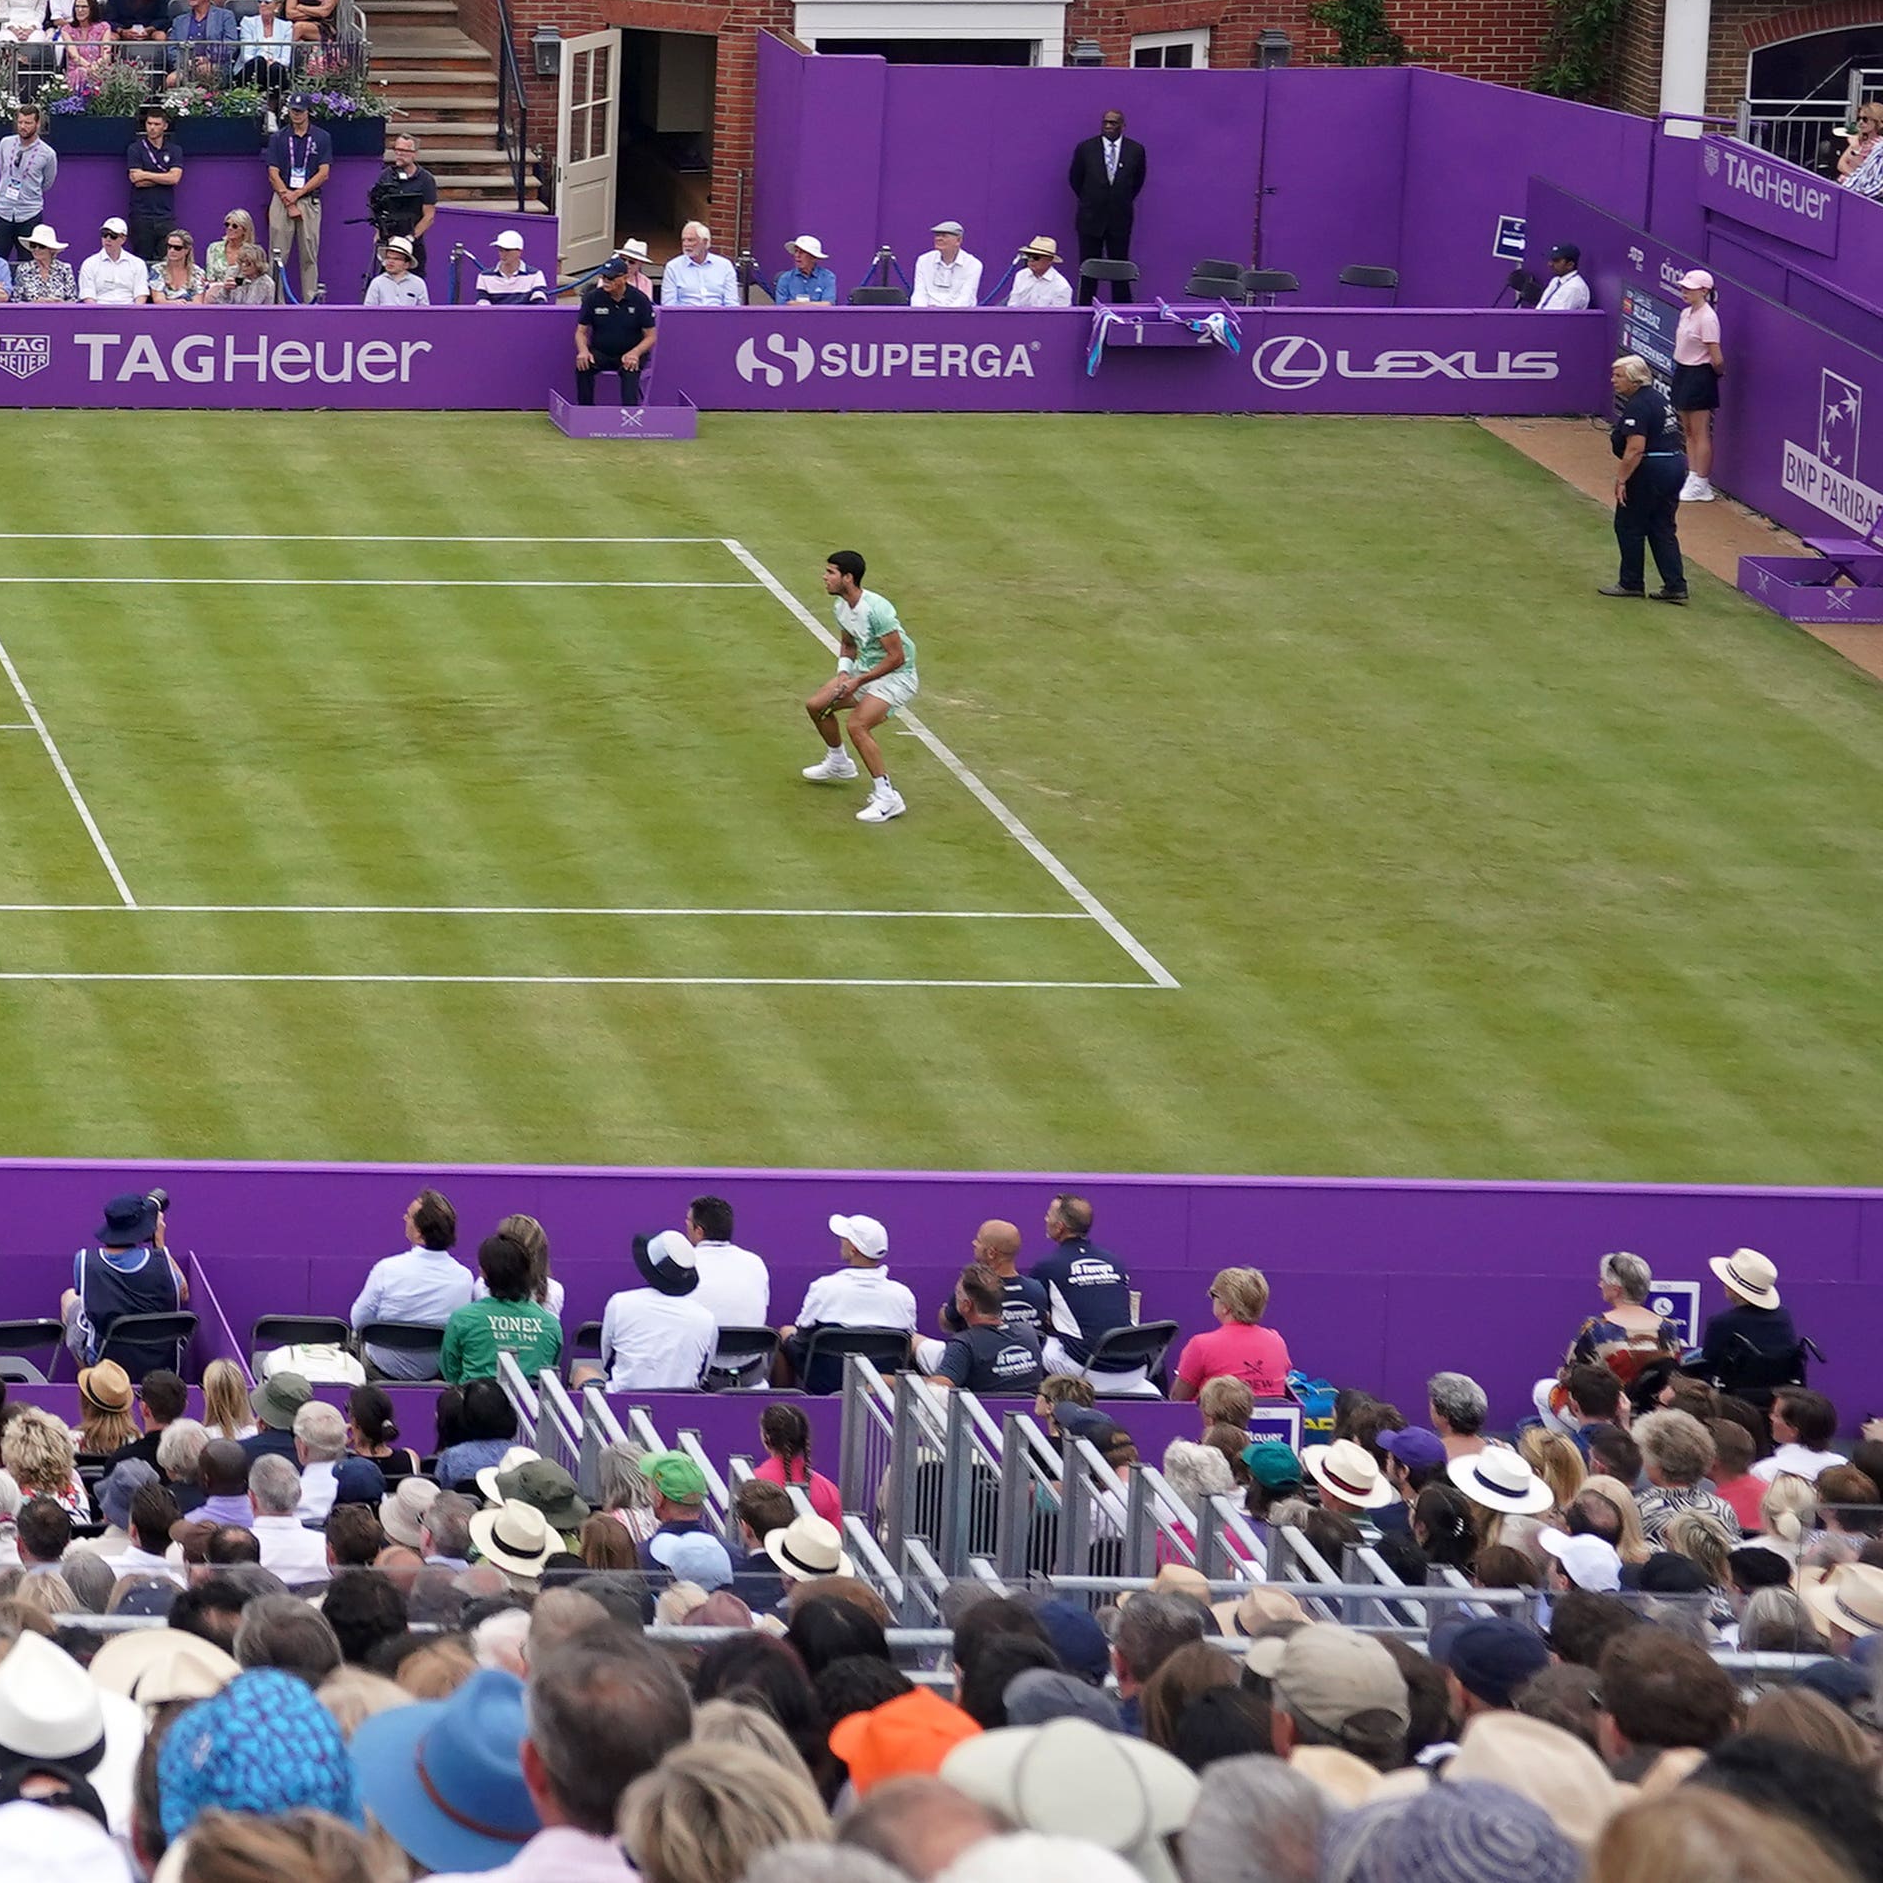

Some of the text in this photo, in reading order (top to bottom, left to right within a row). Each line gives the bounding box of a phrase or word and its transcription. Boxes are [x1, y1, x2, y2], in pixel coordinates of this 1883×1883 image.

[0, 338, 46, 350] TAG
[1134, 324, 1143, 343] 1
[0, 353, 46, 375] HEUER
[820, 343, 1035, 378] SUPERGA
[1336, 349, 1559, 379] LEXUS
[1786, 452, 1817, 494] BNP
[487, 1315, 543, 1333] YONEX
